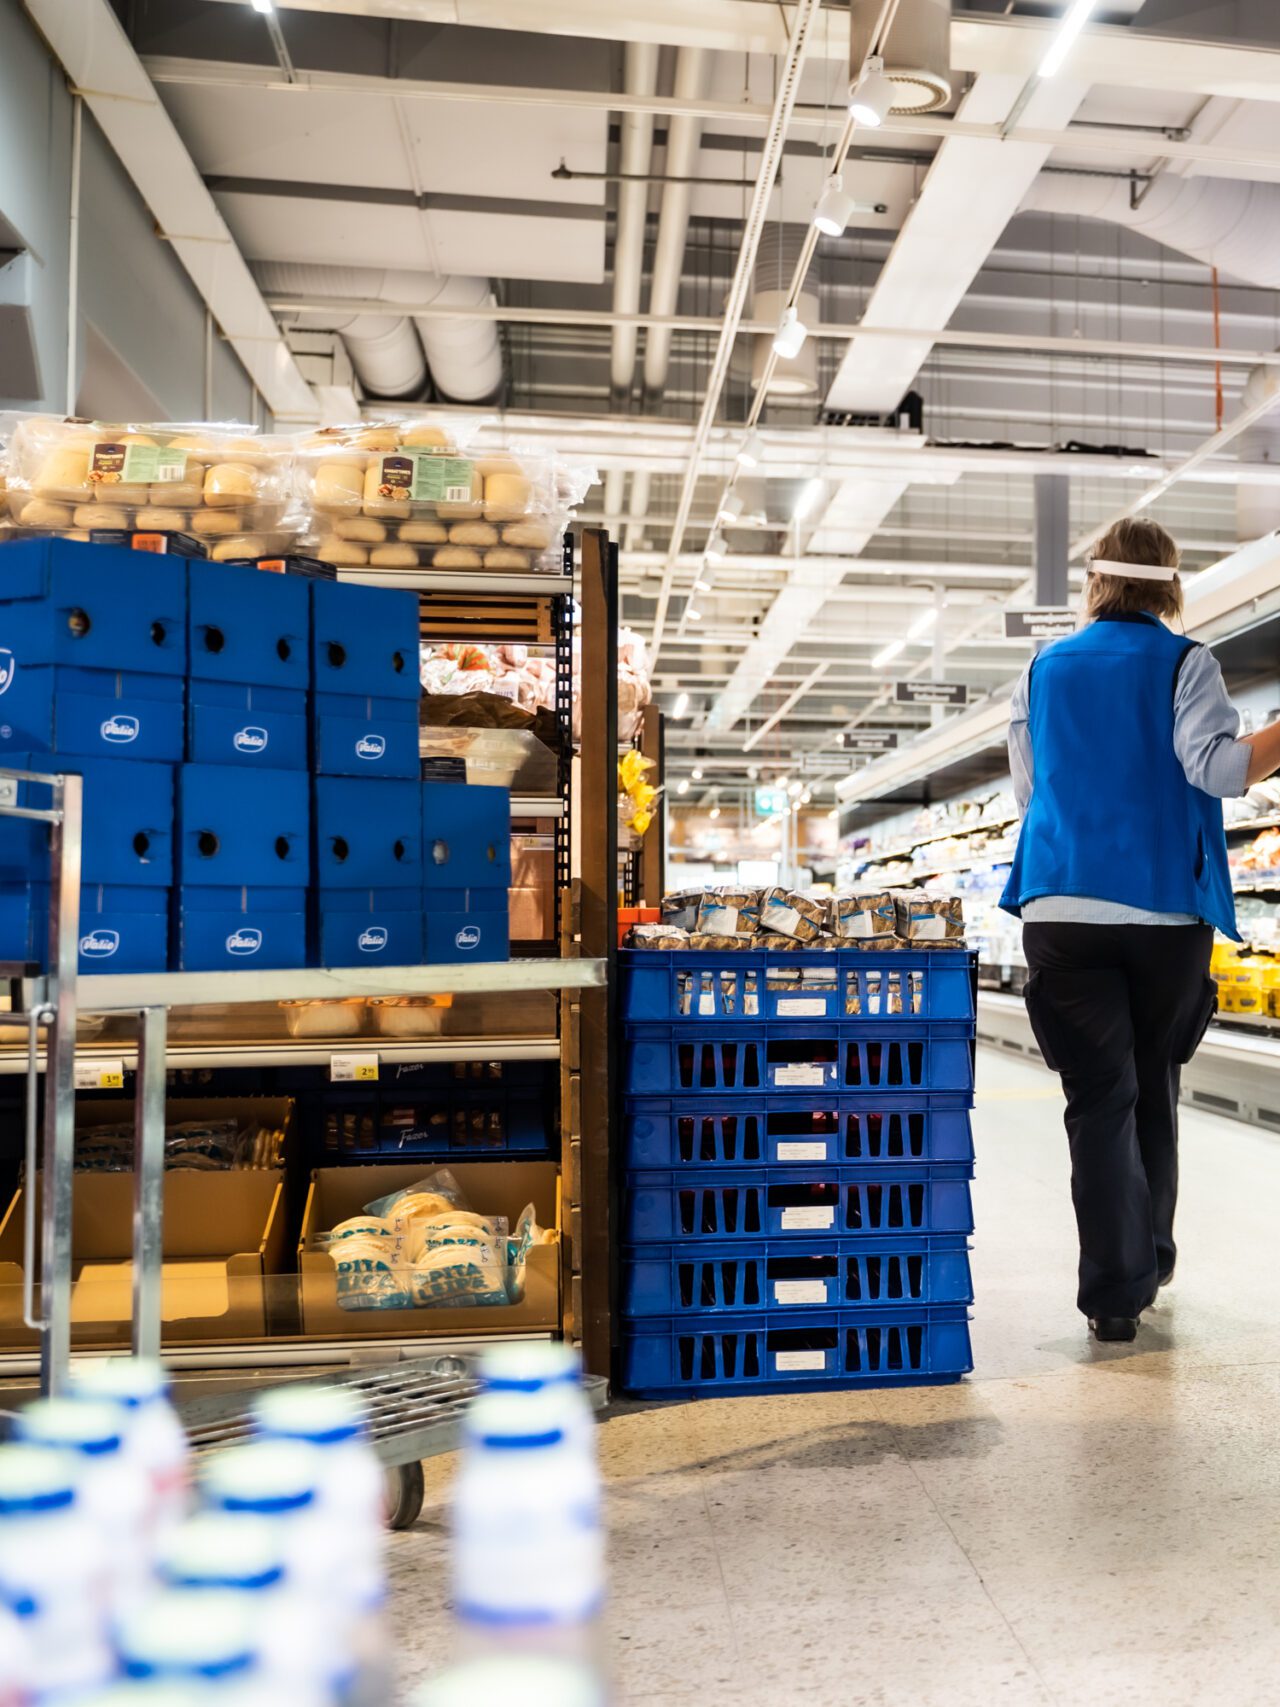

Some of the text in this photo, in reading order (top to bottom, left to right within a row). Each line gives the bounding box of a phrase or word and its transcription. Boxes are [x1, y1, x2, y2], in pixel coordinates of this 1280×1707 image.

[105, 724, 134, 736] Valio
[238, 735, 264, 746] Valio
[84, 936, 115, 950] Valio
[230, 935, 257, 948] Valio
[361, 934, 384, 945] Valio
[399, 1128, 429, 1149] Fazer
[338, 1259, 391, 1273] PITA
[430, 1262, 482, 1284] PITA
